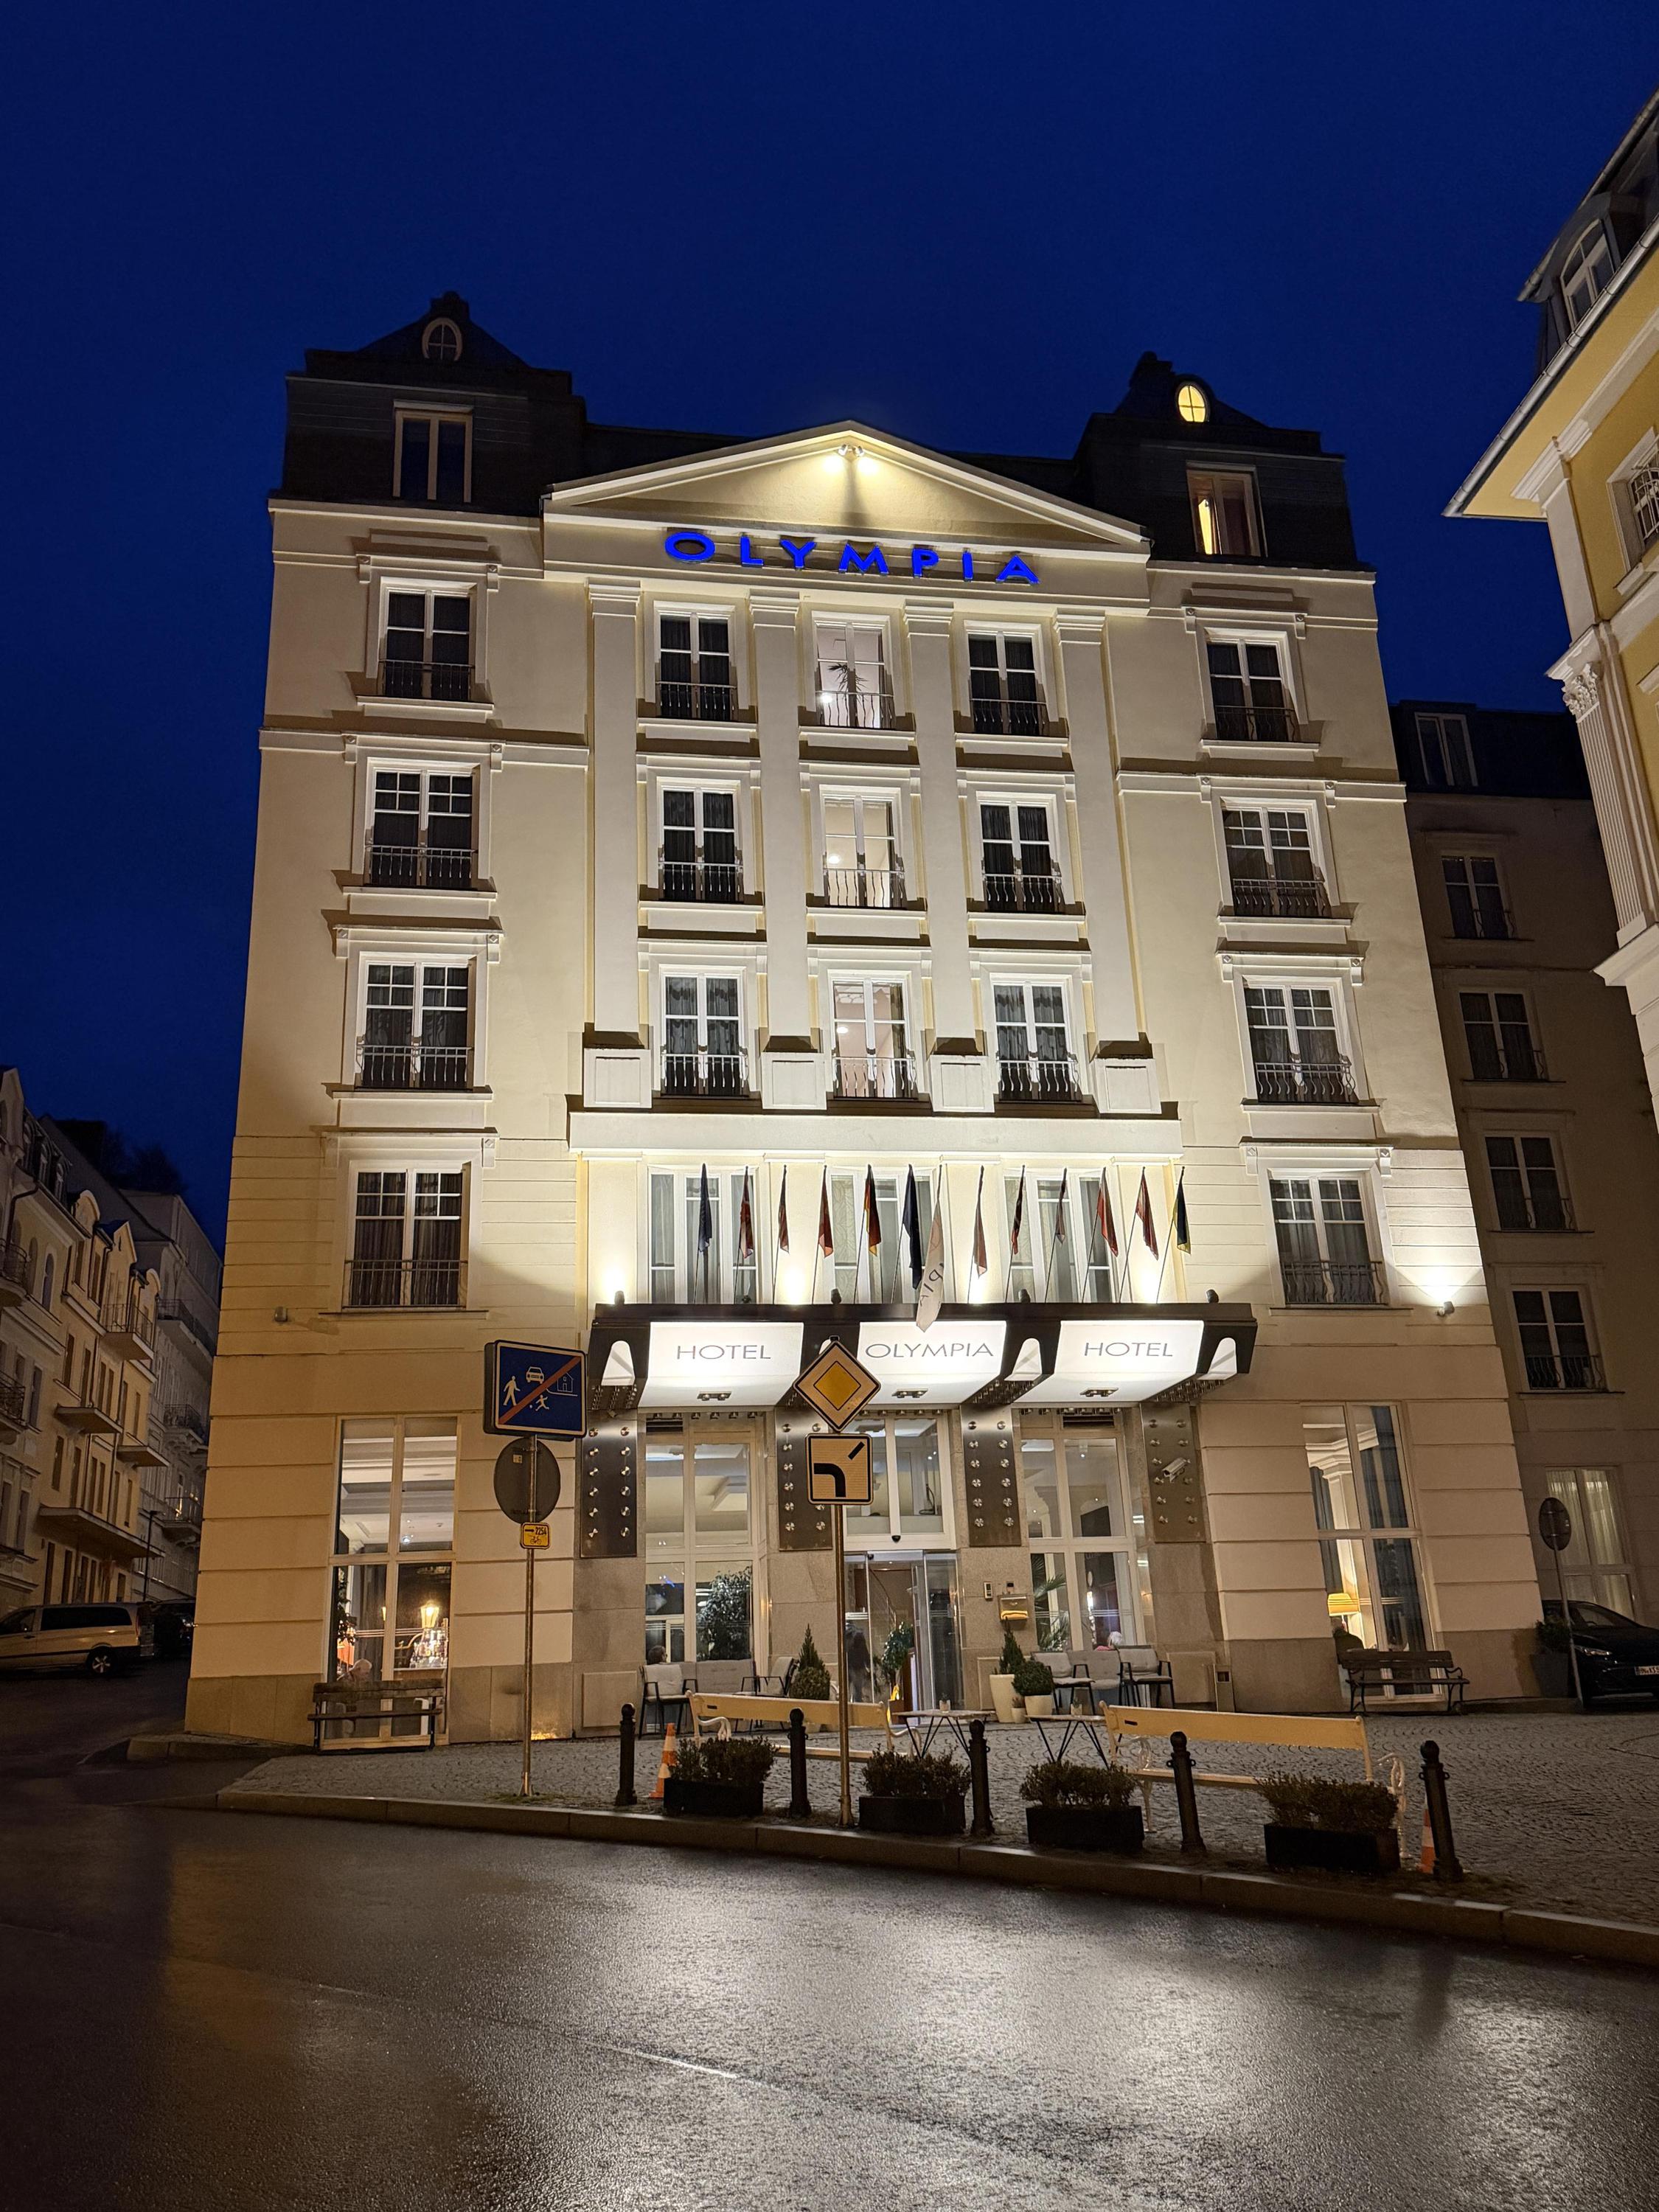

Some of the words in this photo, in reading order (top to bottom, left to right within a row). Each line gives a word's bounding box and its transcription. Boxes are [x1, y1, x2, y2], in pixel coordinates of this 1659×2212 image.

[665, 532, 1040, 585] OLYMPIA
[676, 1344, 771, 1360] HOTEL
[865, 1342, 994, 1358] OLYMPIA
[1083, 1341, 1173, 1357] HOTEL
